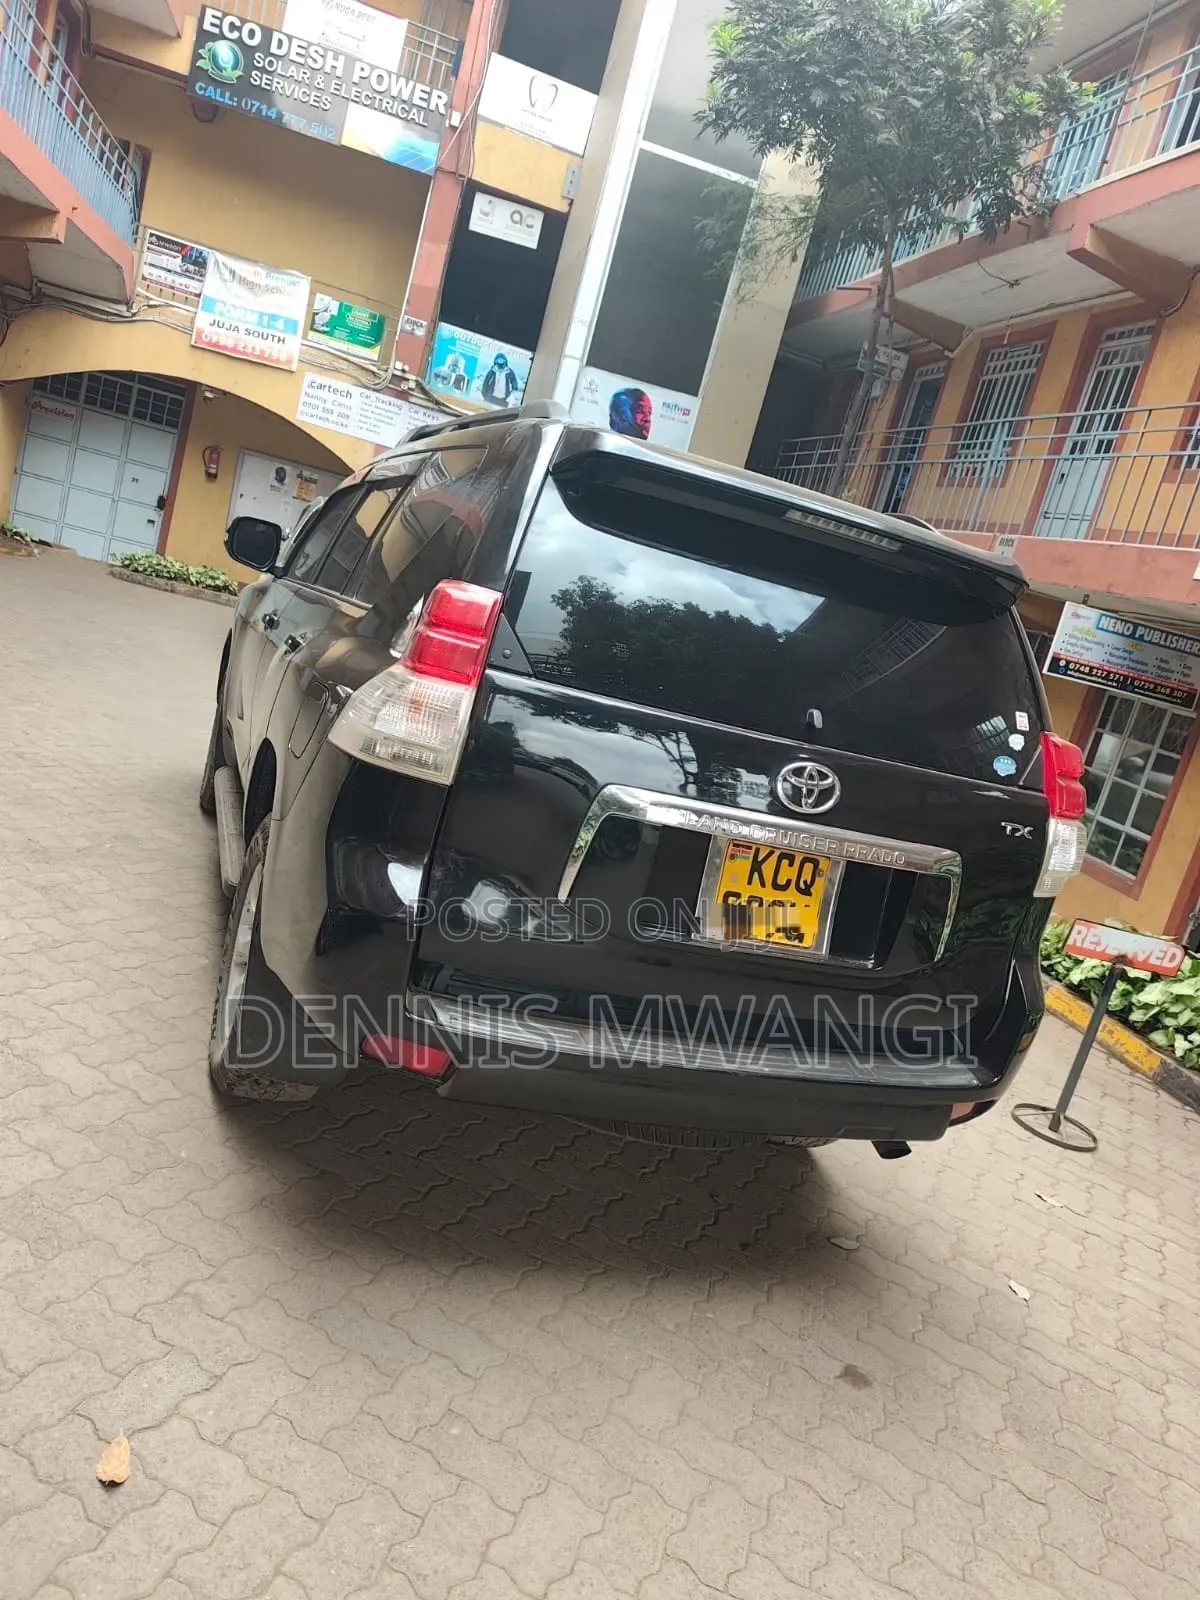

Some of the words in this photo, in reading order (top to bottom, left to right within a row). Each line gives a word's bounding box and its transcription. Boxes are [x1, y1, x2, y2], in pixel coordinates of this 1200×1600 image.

[202, 7, 262, 47] ECO
[270, 31, 344, 77] DESH
[352, 61, 449, 115] POWER
[195, 82, 237, 107] CALL:
[241, 96, 277, 120] 0714
[250, 70, 332, 111] SERVICES
[253, 52, 310, 84] SOLAR
[314, 74, 325, 90] &
[330, 79, 429, 127] ELECTRICAL
[208, 318, 240, 335] JUJA
[244, 327, 287, 345] SOUTH
[309, 379, 353, 400] cartech
[1098, 614, 1134, 636] NENO
[1135, 624, 1200, 656] PUBLISHER
[684, 811, 743, 835] LAND
[751, 825, 839, 854] CRUISER
[843, 842, 906, 866] PRADO
[1001, 821, 1034, 840] TX
[747, 847, 820, 897] KCQ
